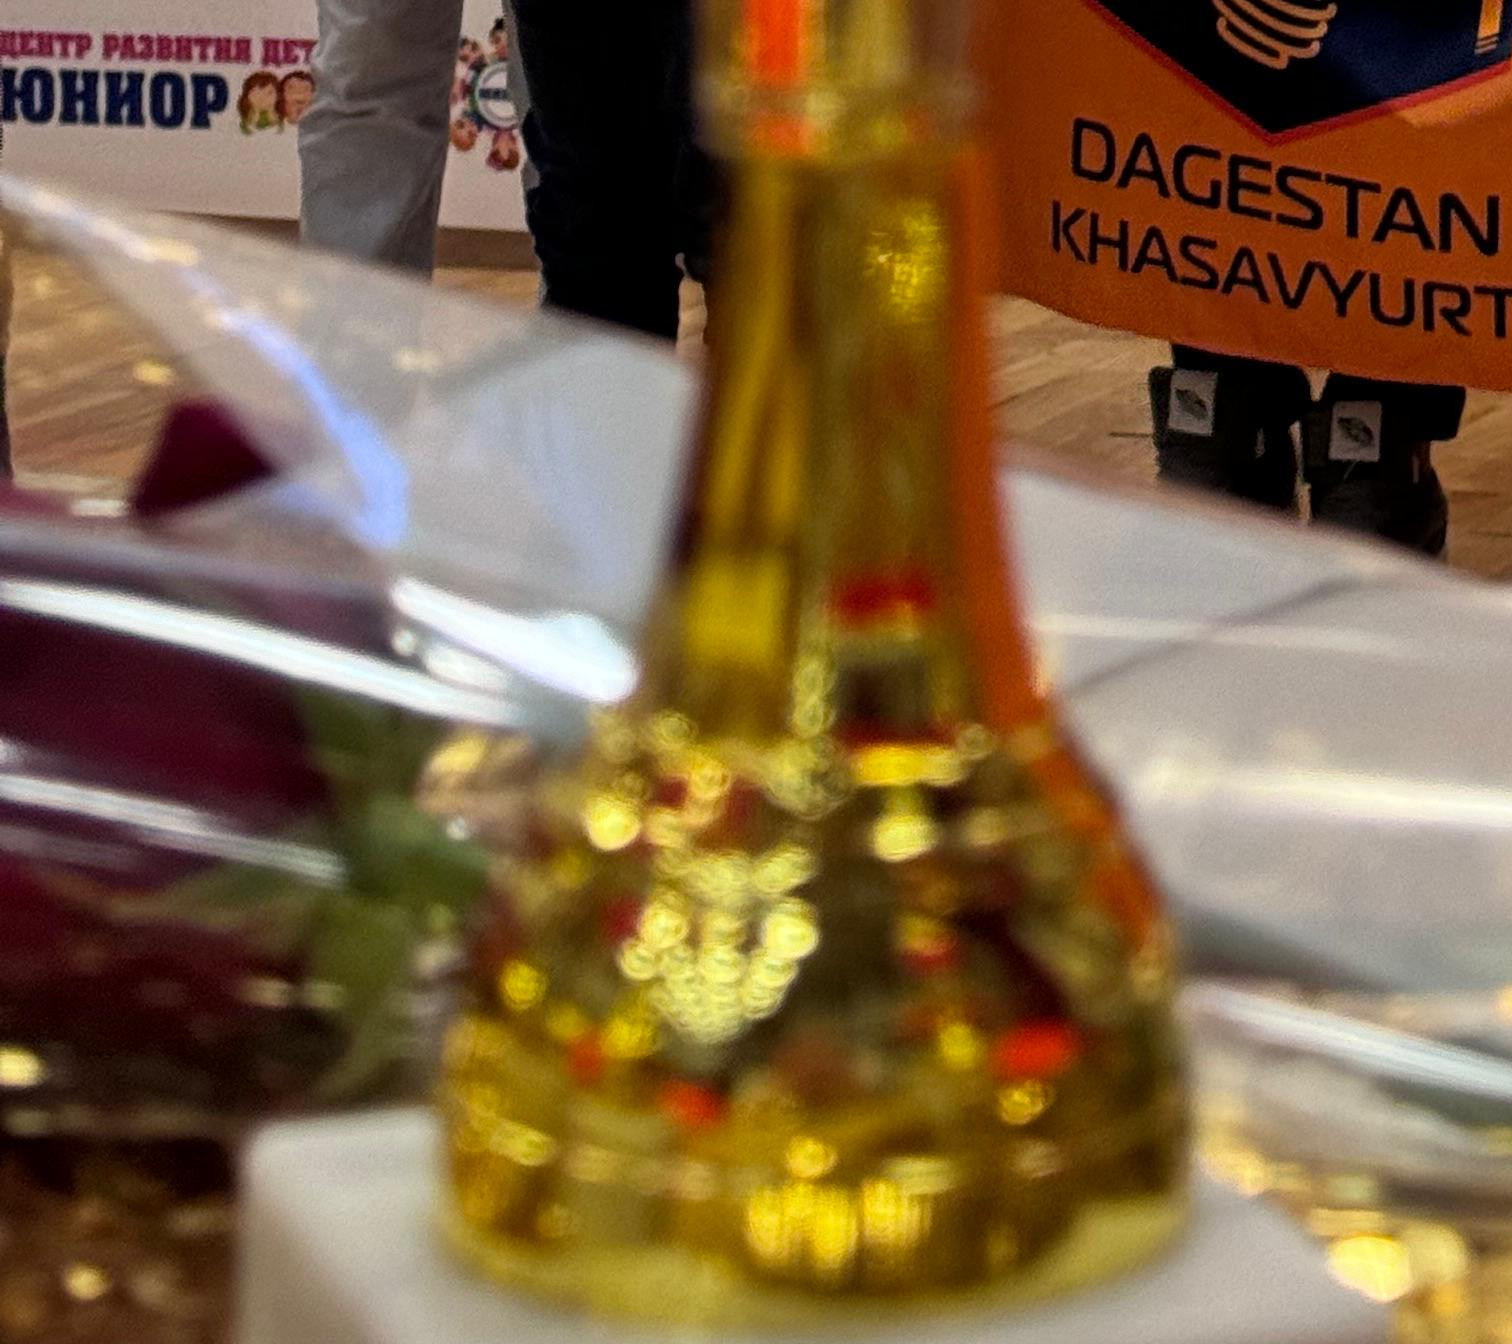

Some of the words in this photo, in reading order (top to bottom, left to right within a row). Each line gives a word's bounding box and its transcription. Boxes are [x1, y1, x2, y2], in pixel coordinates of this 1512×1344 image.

[102, 33, 252, 64] РАЗВИТИЯ
[0, 66, 230, 130] ЮНИОР
[1070, 117, 1501, 257] DAGESTAN
